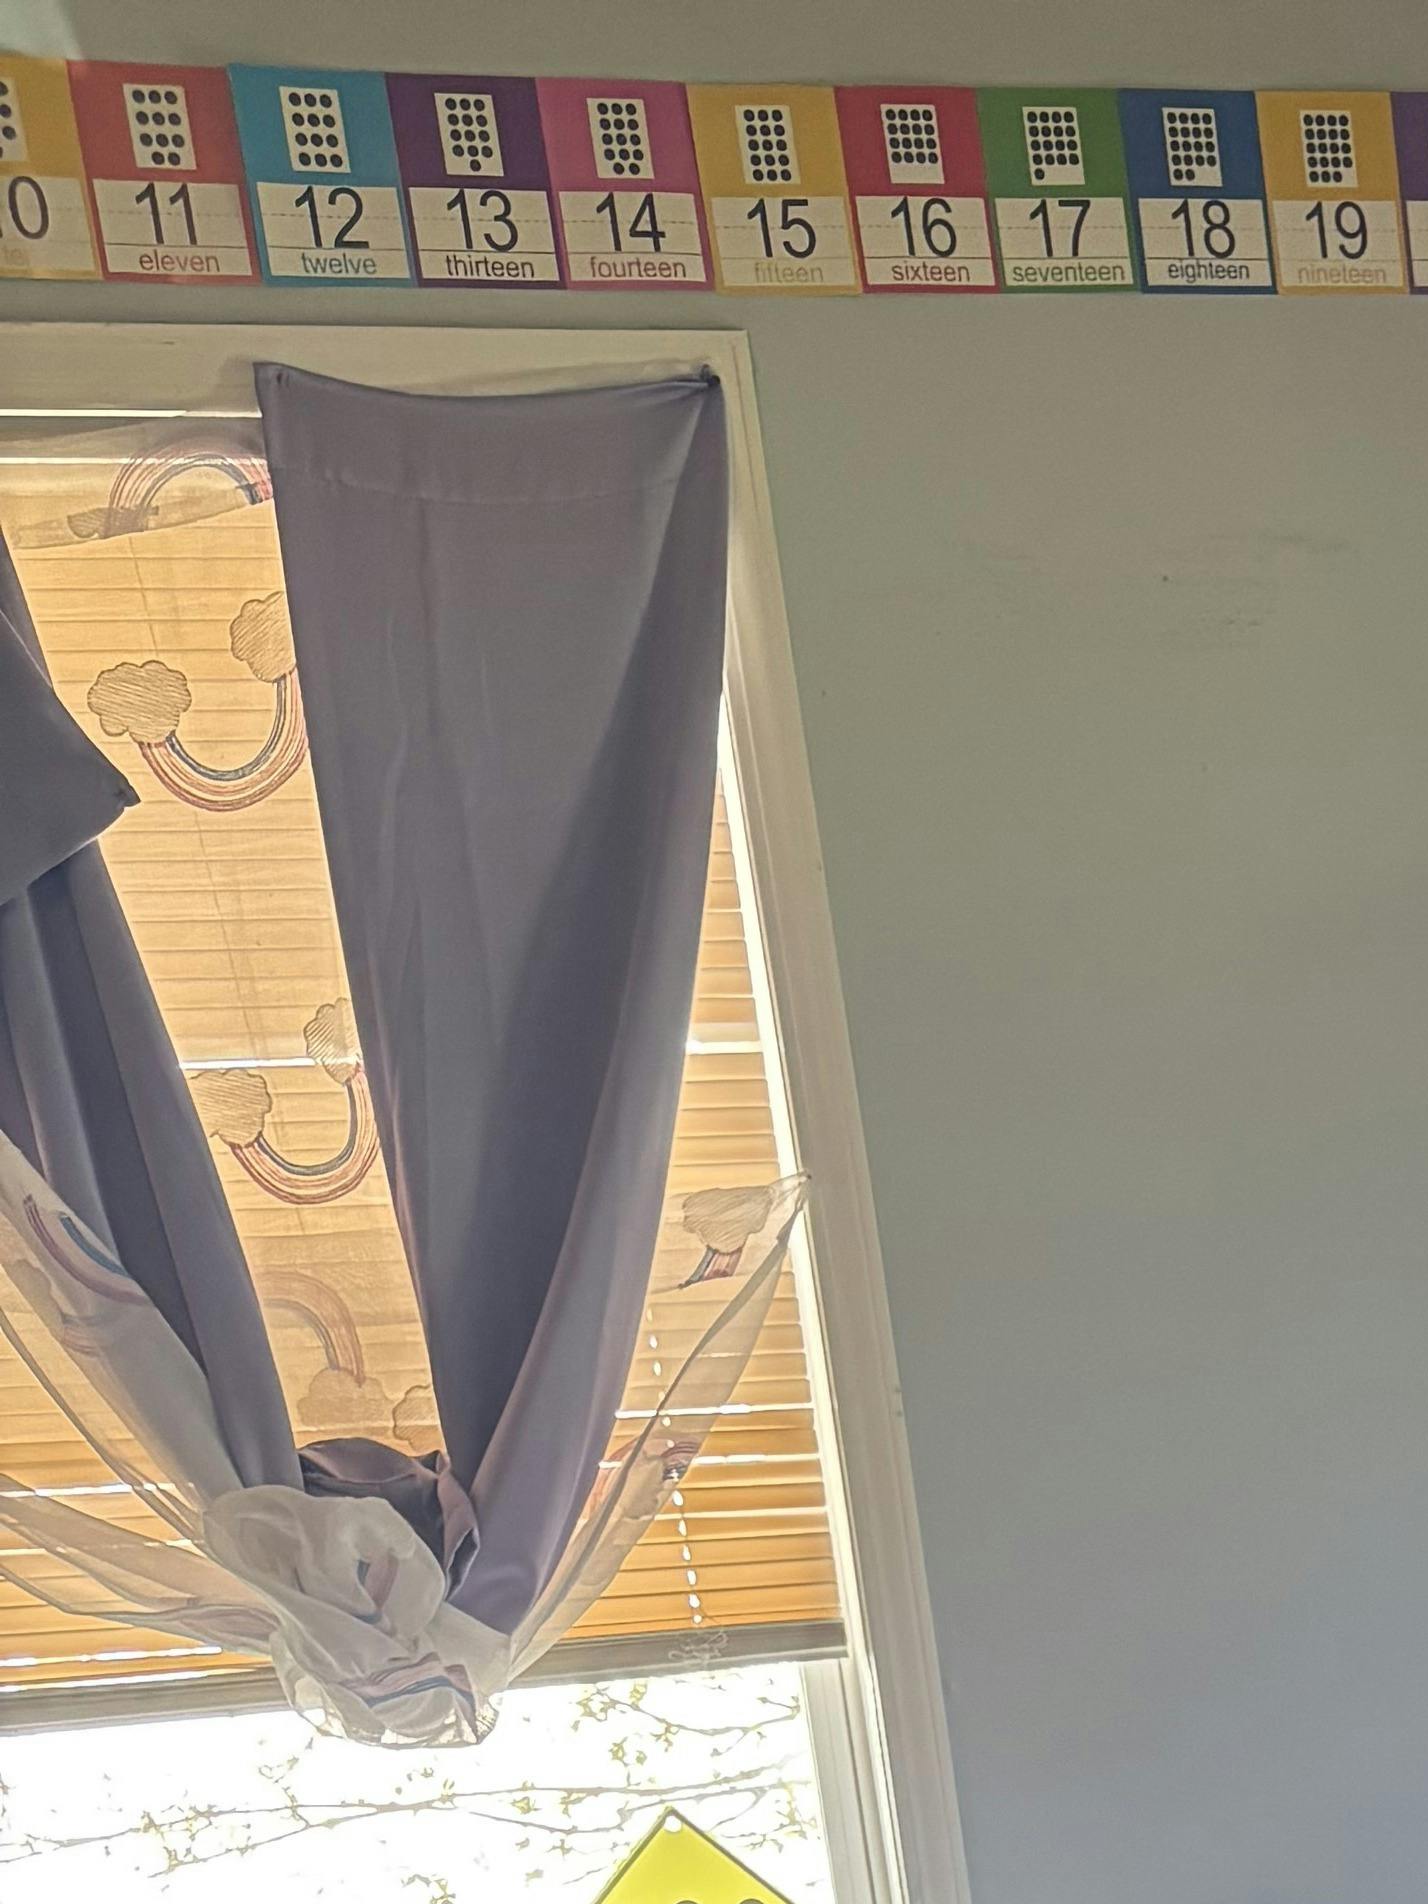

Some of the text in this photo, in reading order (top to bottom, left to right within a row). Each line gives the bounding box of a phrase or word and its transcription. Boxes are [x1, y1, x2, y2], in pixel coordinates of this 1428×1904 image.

[0, 175, 50, 241] 0
[134, 181, 198, 246] 11
[294, 184, 370, 249] 12
[446, 188, 519, 253] 13
[595, 191, 667, 253] 14
[746, 198, 817, 259] 15
[890, 196, 957, 258] 16
[1028, 198, 1091, 258] 17
[1171, 199, 1236, 259] 18
[1305, 200, 1368, 260] 19
[138, 248, 221, 273] eleven
[300, 251, 378, 275] twelve
[445, 253, 535, 279] thirteen
[590, 255, 687, 279] fourteen
[754, 262, 825, 283] fifteen
[891, 260, 971, 283] sixteen
[1012, 261, 1126, 283] seventeen
[1168, 261, 1251, 284] eighteen
[1298, 263, 1387, 284] nineteen
